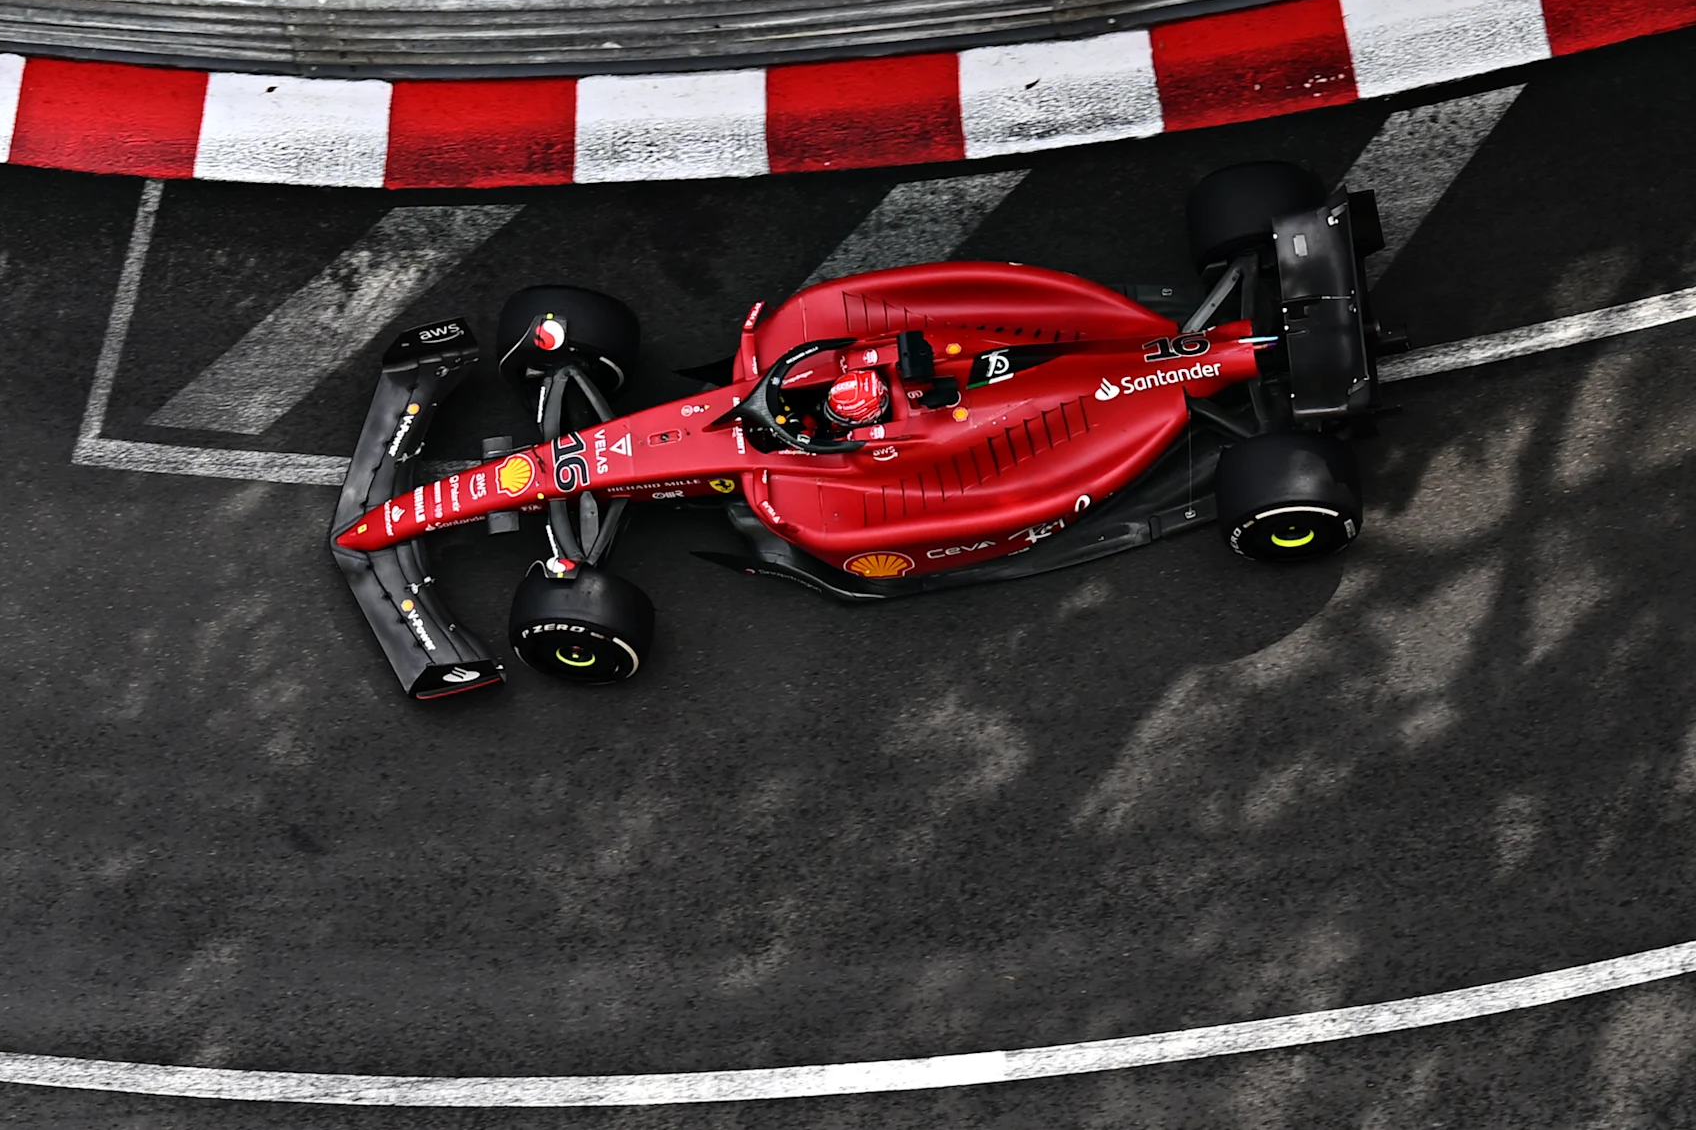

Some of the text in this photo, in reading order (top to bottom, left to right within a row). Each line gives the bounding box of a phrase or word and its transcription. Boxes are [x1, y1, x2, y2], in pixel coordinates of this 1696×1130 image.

[418, 323, 464, 343] aws
[1142, 331, 1211, 362] 16
[1120, 362, 1221, 395] Santander
[551, 430, 591, 492] 16
[594, 429, 609, 475] VELAS
[474, 472, 487, 498] aws
[664, 478, 702, 487] MILLE
[435, 515, 486, 530] Santande
[407, 609, 437, 651] V-Power
[521, 623, 586, 639] P ZERO
